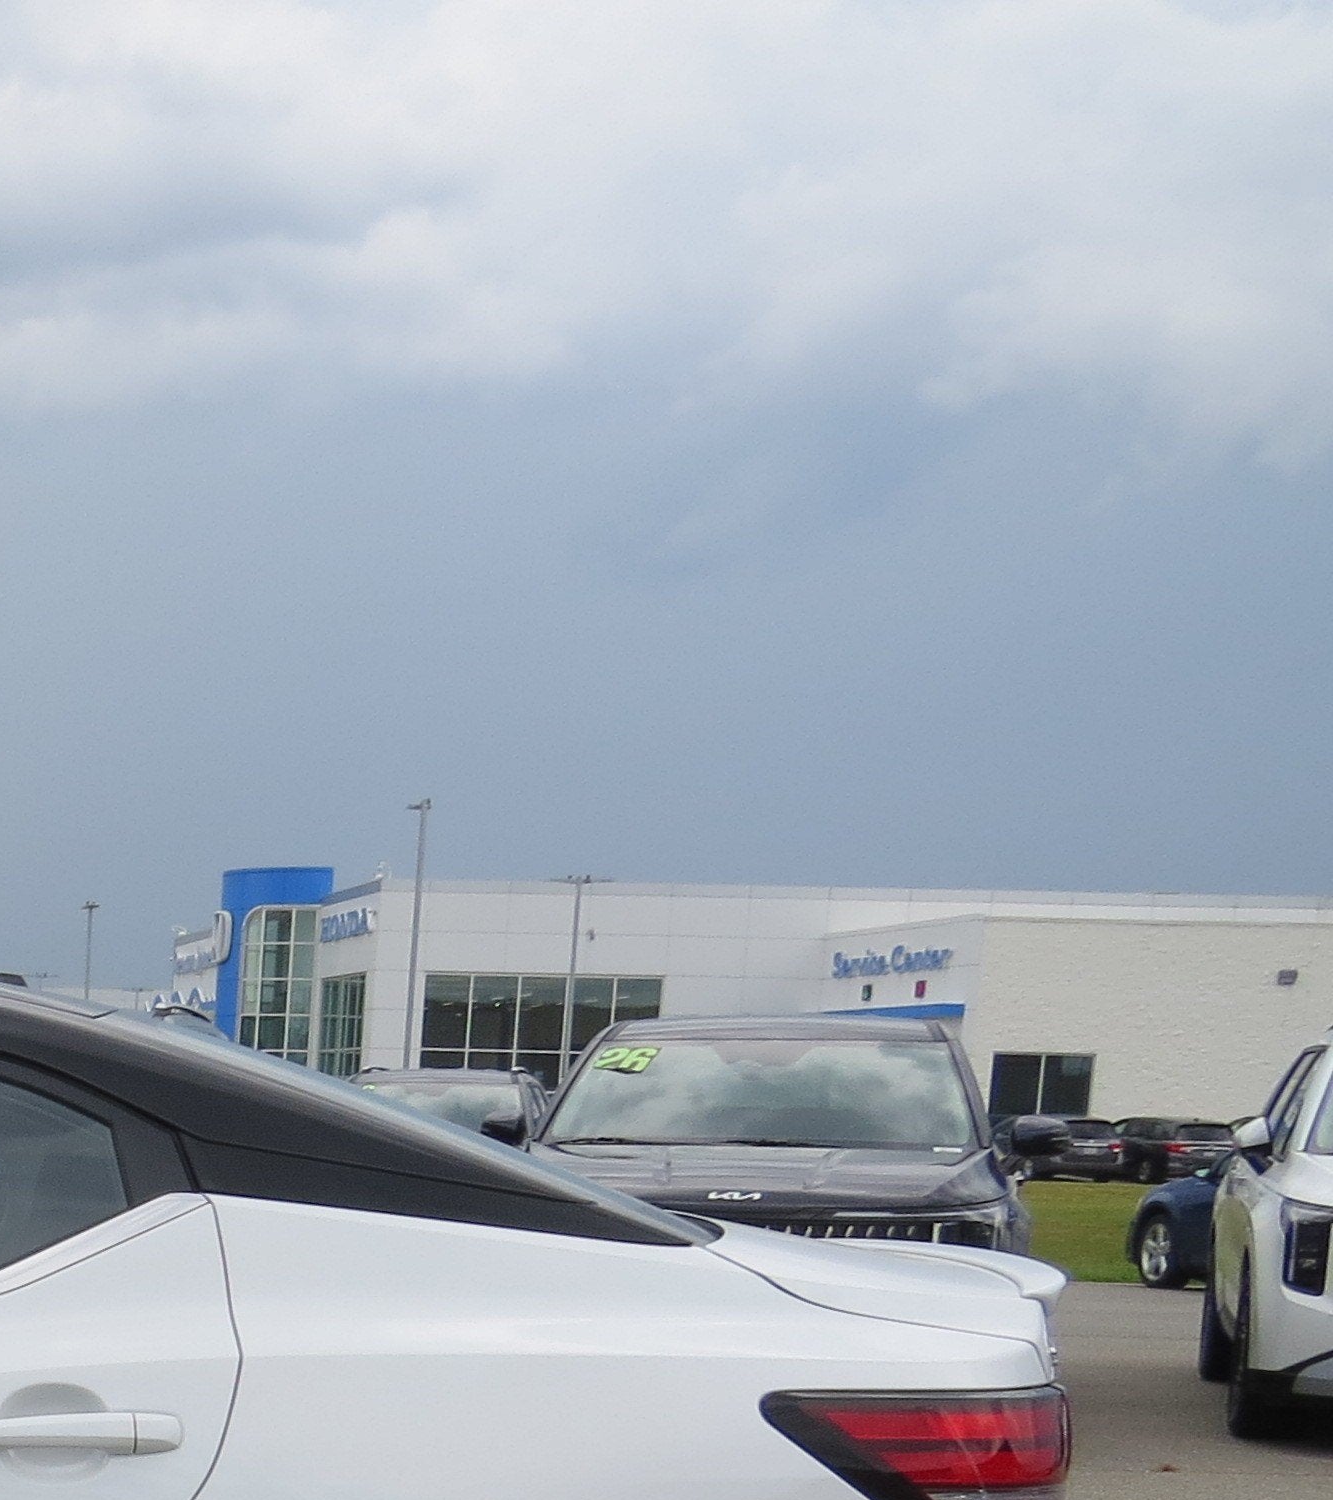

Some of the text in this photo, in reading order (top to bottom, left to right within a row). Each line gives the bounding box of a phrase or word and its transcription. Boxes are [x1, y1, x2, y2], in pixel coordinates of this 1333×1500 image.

[321, 909, 370, 943] HONDA
[832, 945, 953, 979] Service Center
[593, 1047, 661, 1073] 26
